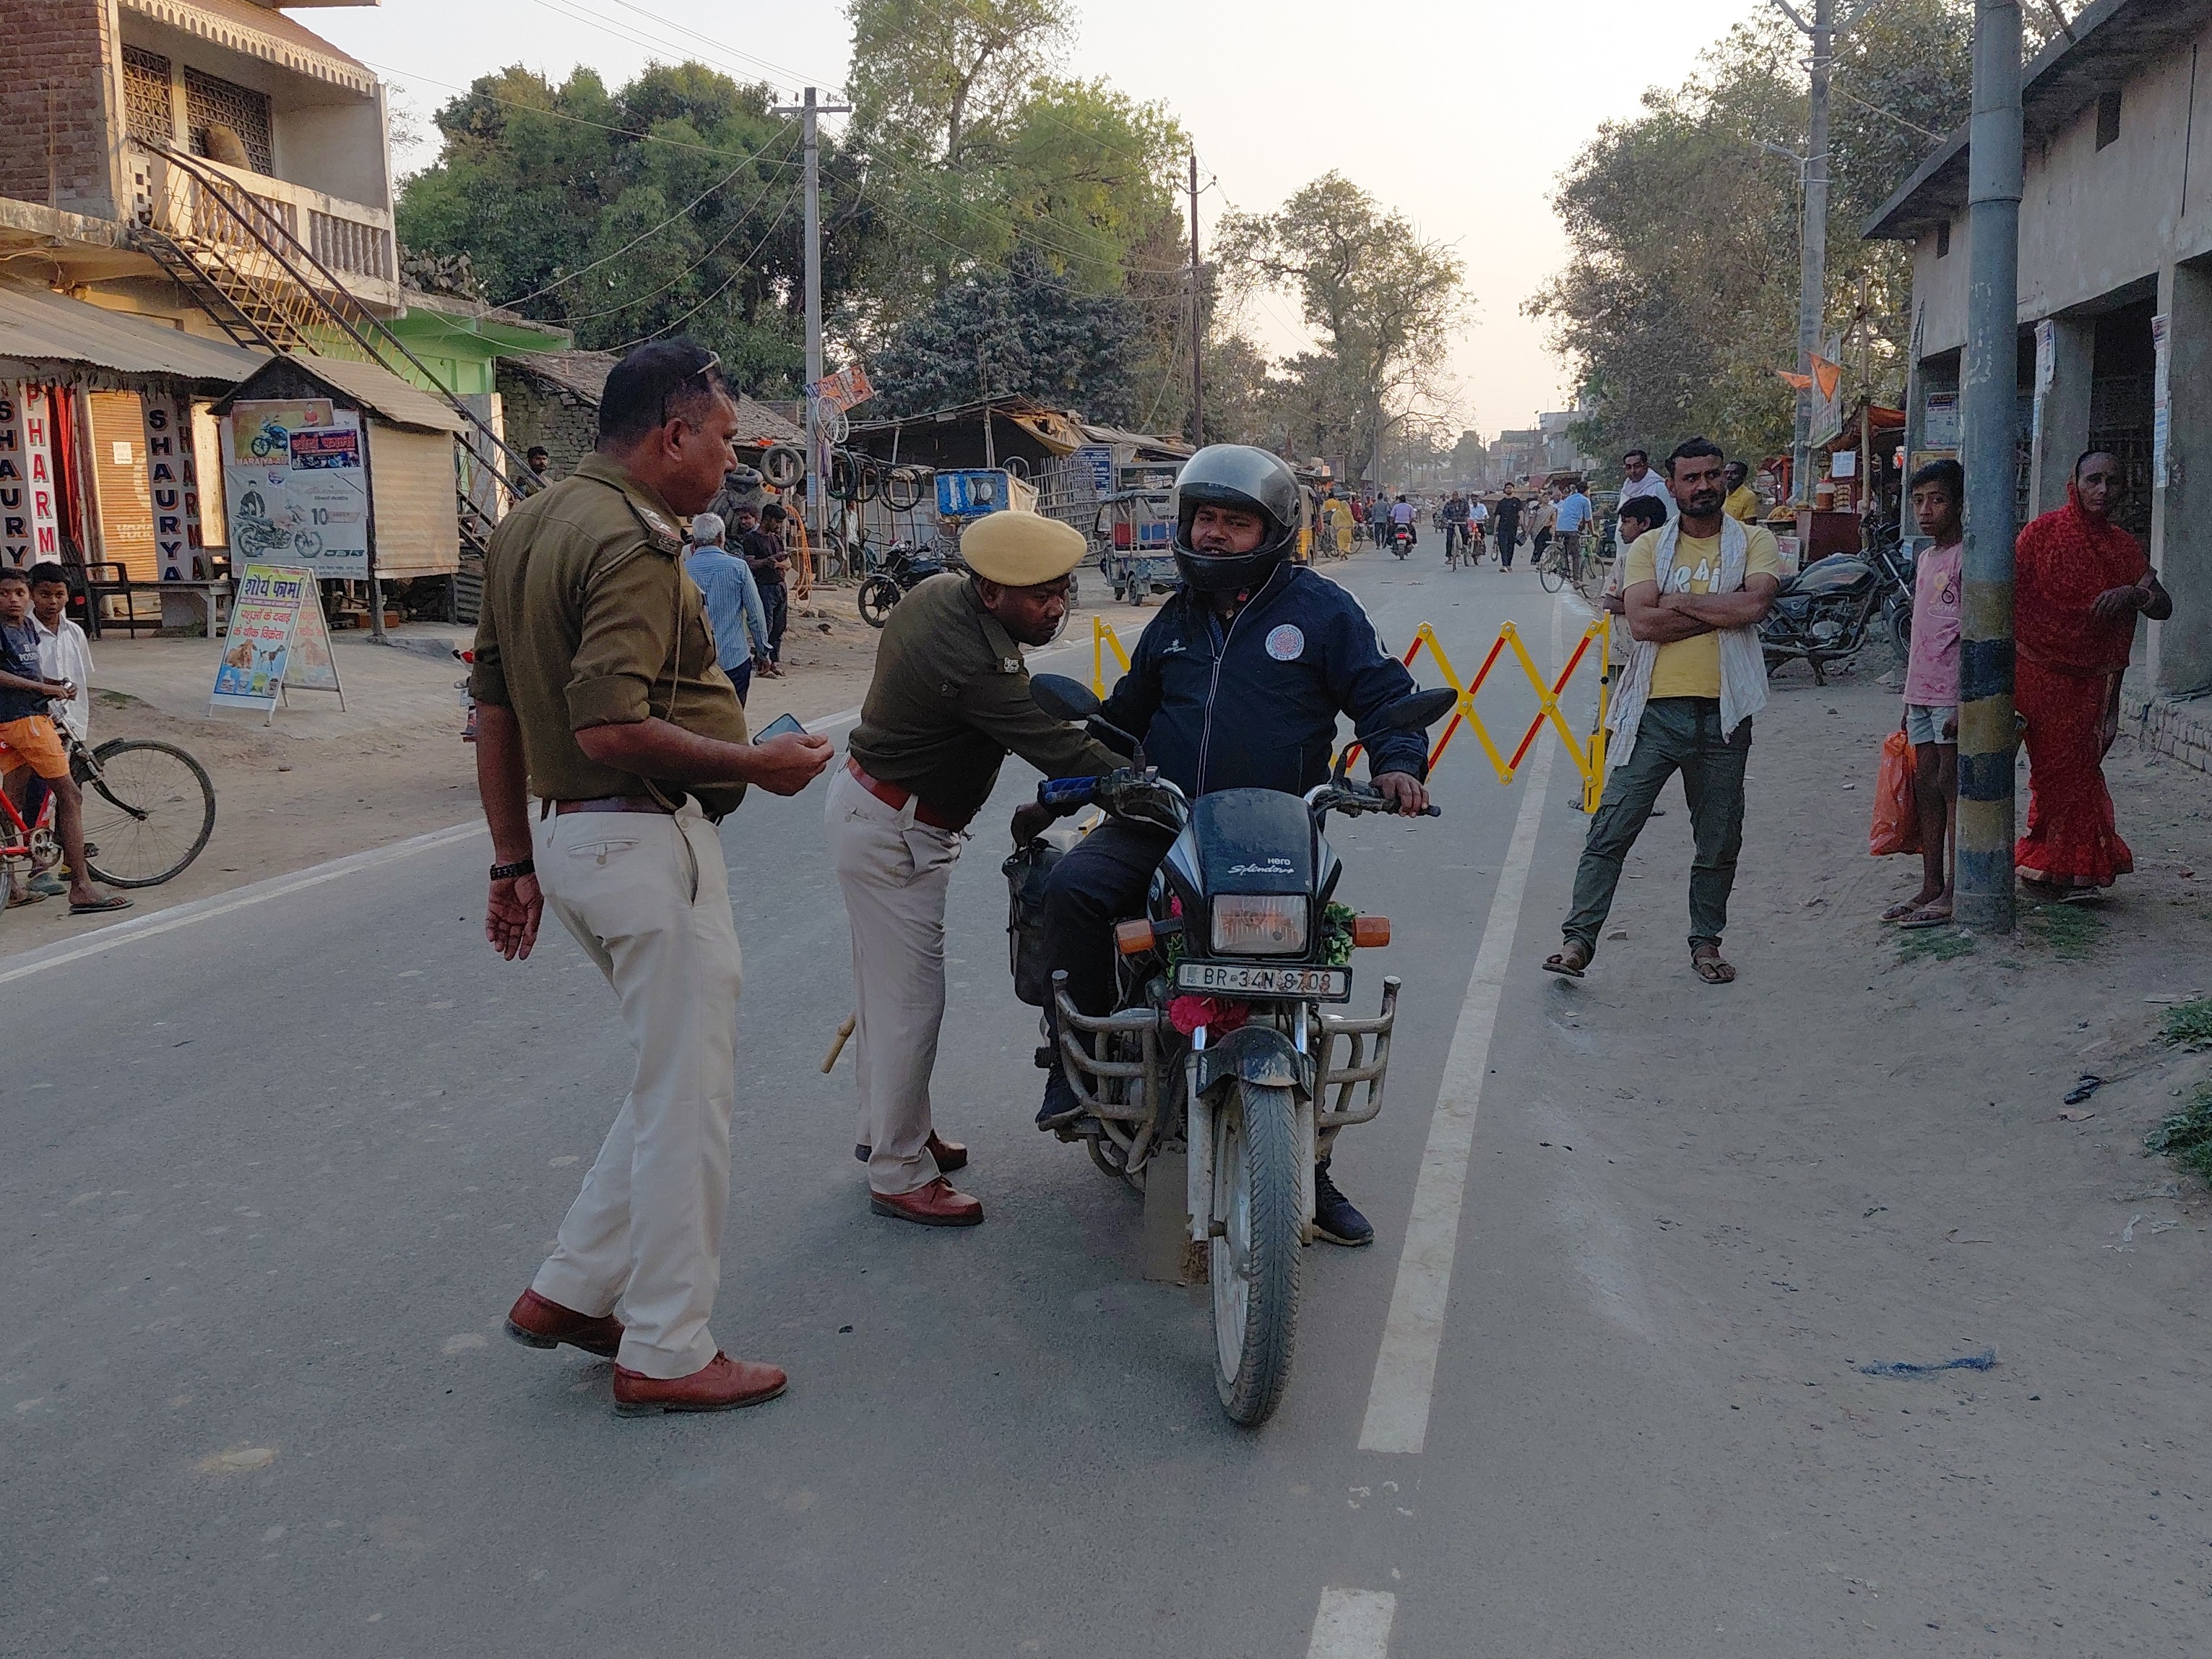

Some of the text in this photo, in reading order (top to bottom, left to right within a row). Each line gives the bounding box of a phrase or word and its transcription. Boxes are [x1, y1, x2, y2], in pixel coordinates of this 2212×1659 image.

[149, 409, 183, 580] SHAURYA
[178, 425, 204, 580] HARMA
[311, 507, 329, 525] 10
[245, 574, 304, 599] शौर्य फार्मा
[241, 608, 264, 625] पशुओं
